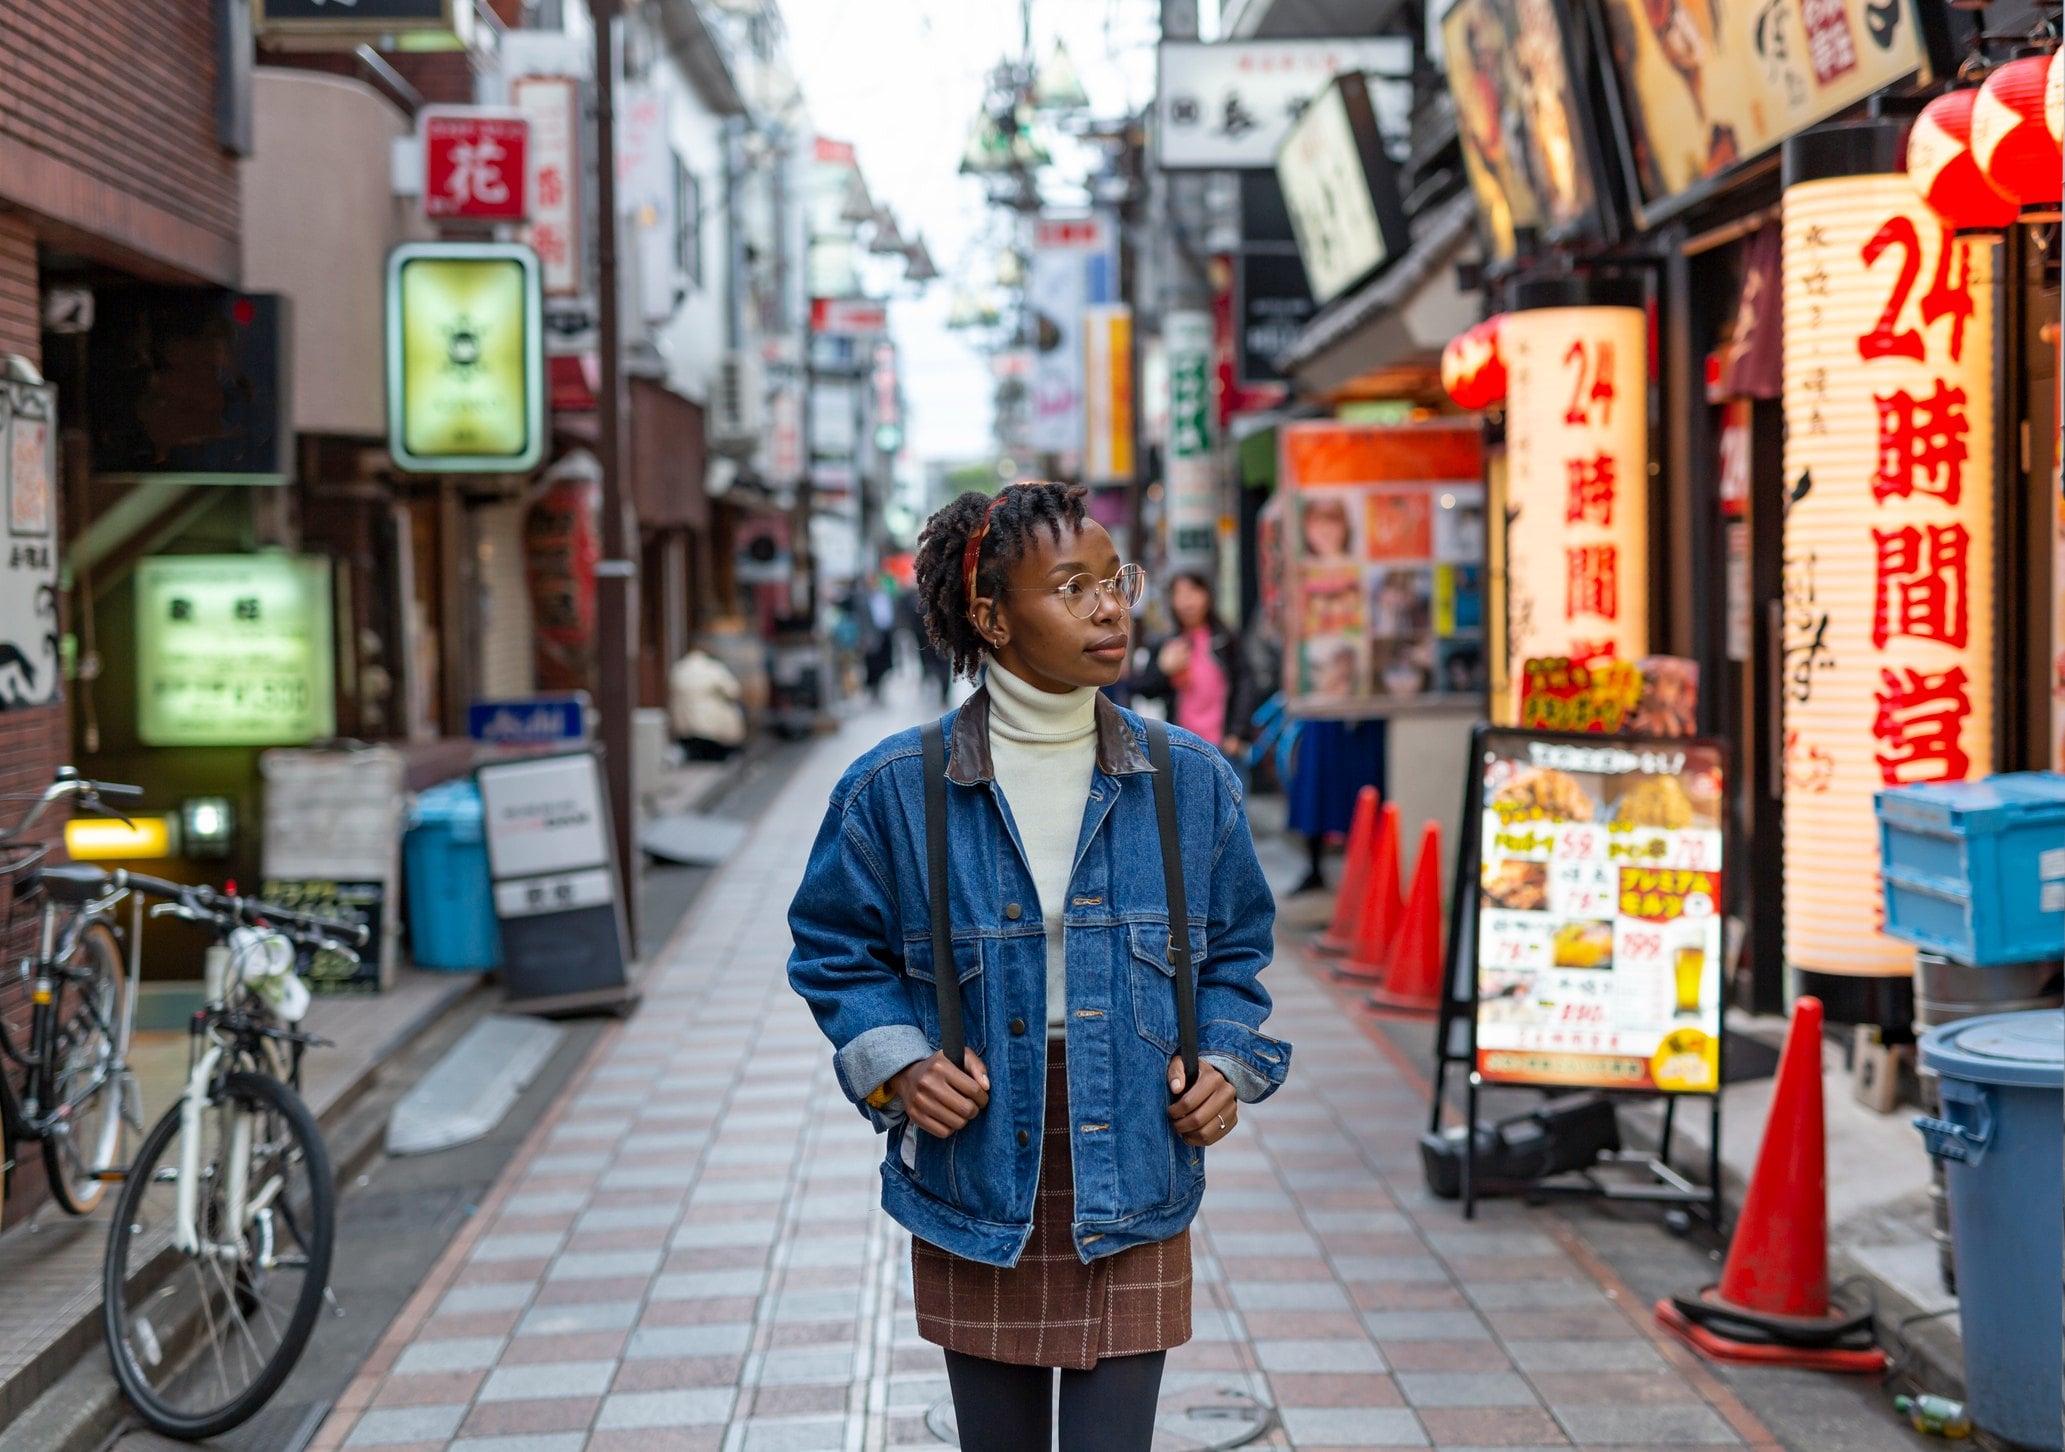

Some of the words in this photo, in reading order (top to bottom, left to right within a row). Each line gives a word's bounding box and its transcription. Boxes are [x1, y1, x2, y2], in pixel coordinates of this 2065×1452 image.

[443, 142, 510, 205] 花
[1857, 215, 1974, 786] 24時間営
